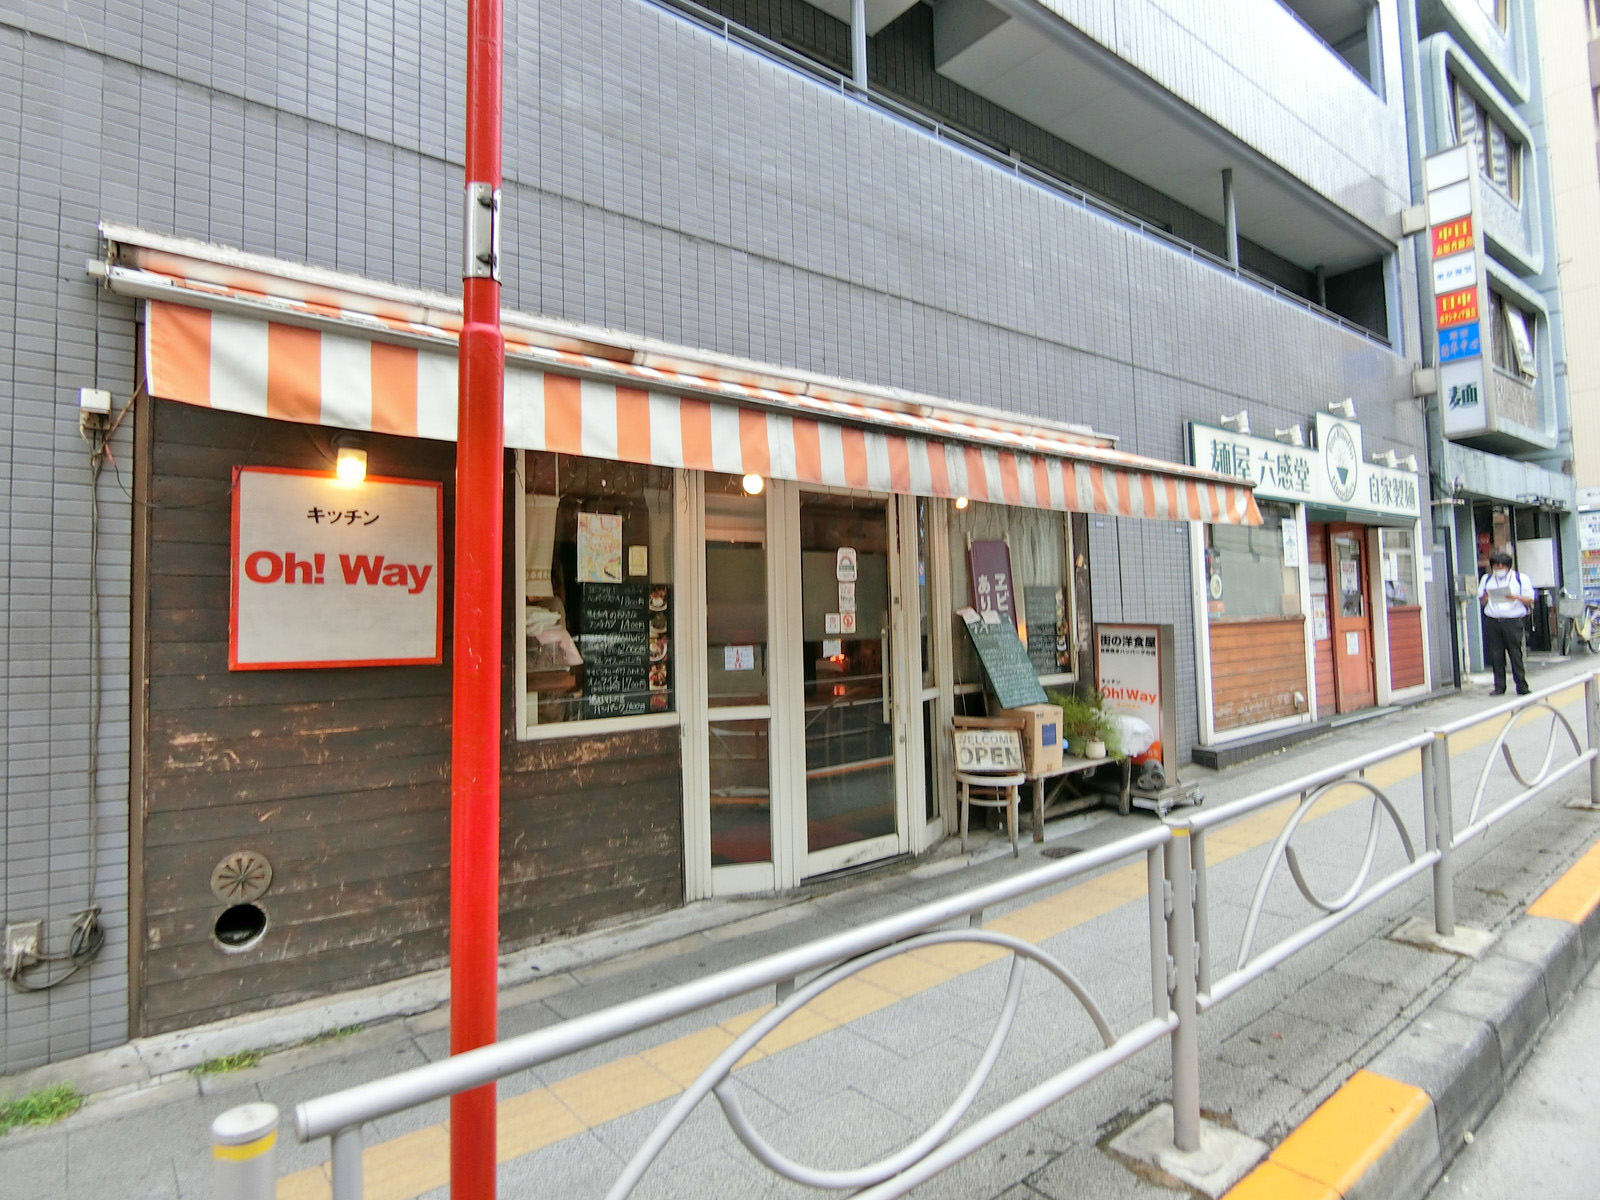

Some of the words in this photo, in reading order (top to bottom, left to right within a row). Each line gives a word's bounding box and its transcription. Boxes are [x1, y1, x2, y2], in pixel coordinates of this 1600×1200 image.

[307, 507, 380, 525] キッチン
[244, 551, 325, 584] Oh!
[339, 554, 432, 594] Way
[1101, 635, 1156, 648] 街の洋食屋
[1101, 686, 1124, 700] Oh!
[1126, 688, 1157, 705] Way
[960, 747, 1019, 767] OPEN
